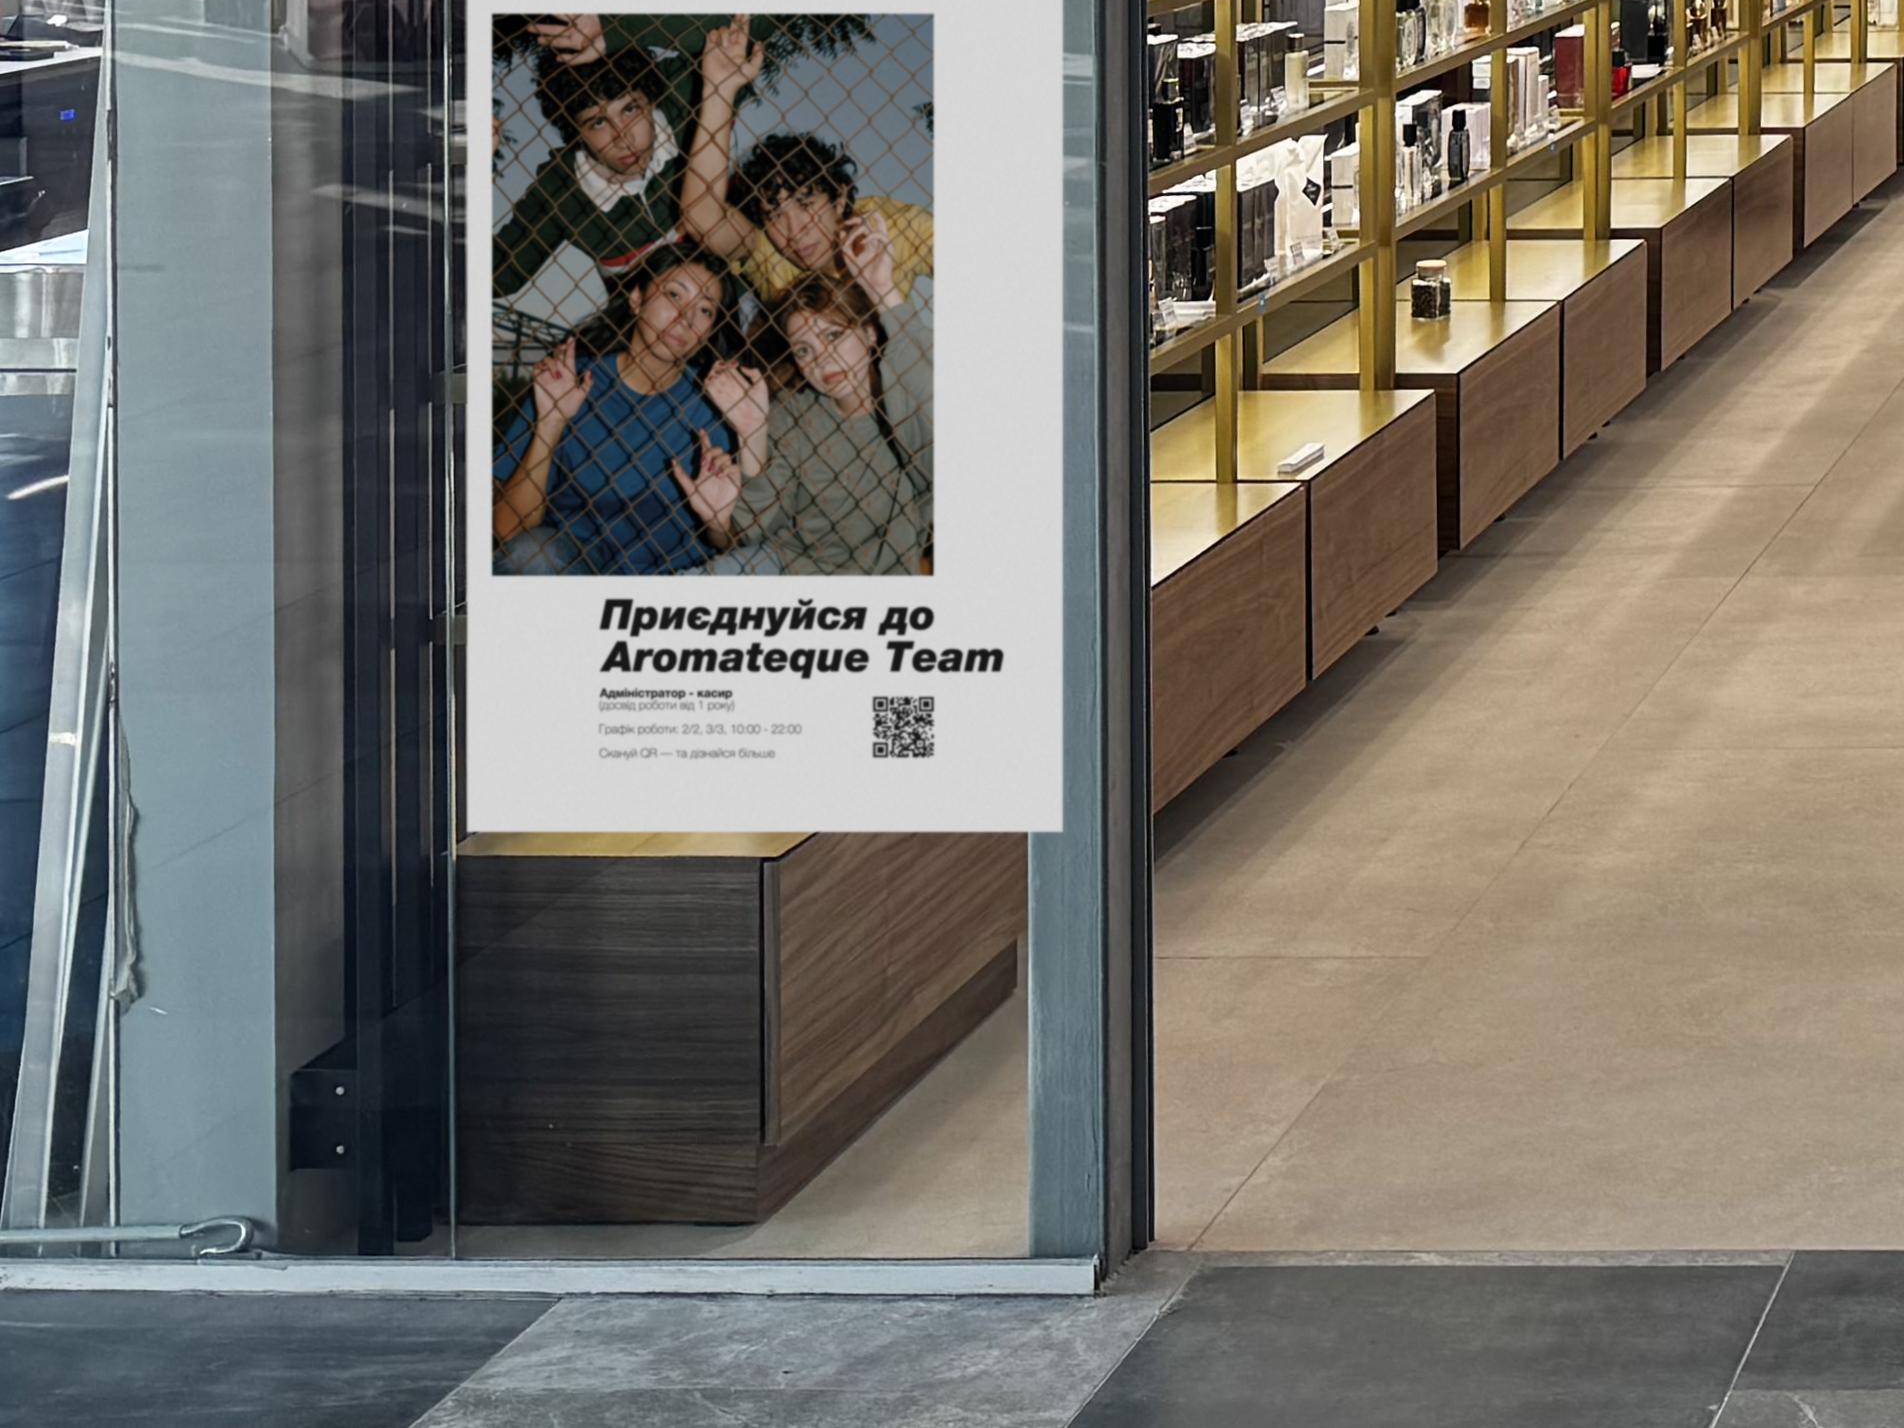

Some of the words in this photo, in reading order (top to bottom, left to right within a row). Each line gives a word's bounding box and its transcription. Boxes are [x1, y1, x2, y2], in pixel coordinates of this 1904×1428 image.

[599, 598, 868, 638] Приєднуйся
[877, 605, 935, 637] до
[599, 640, 870, 680] Aromateque
[886, 640, 1005, 674] Team
[599, 687, 687, 701] Адміністратор
[696, 689, 734, 701] касир
